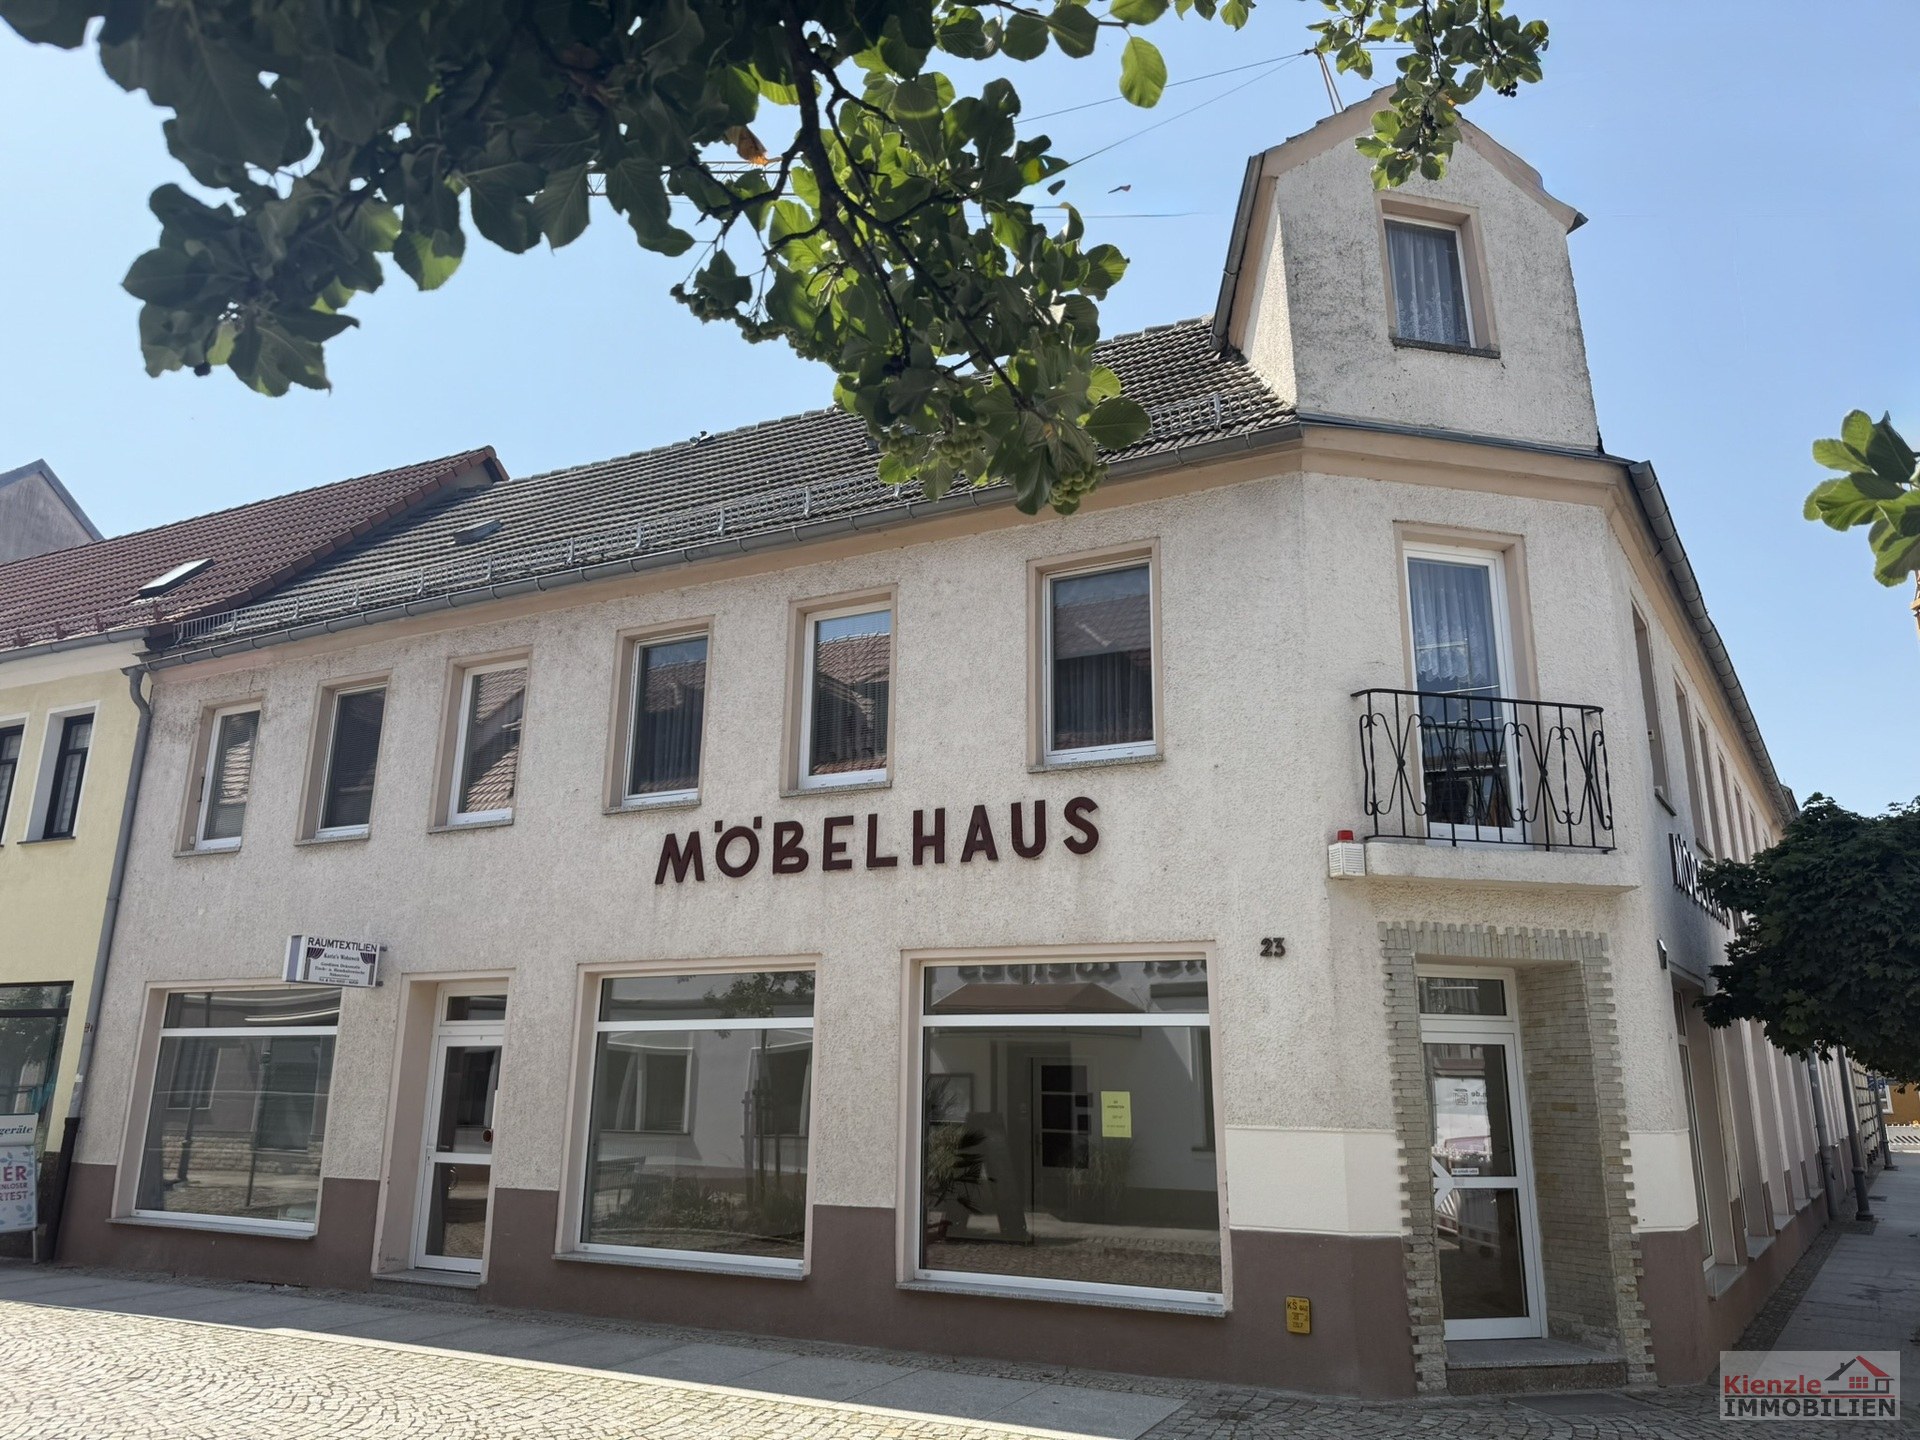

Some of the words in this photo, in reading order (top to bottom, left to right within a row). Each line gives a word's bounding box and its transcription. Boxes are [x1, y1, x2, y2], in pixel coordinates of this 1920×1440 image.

[653, 795, 1100, 885] MÖBELHAUS
[308, 937, 378, 952] RAUMTEXTILIEN
[1260, 938, 1286, 957] 23
